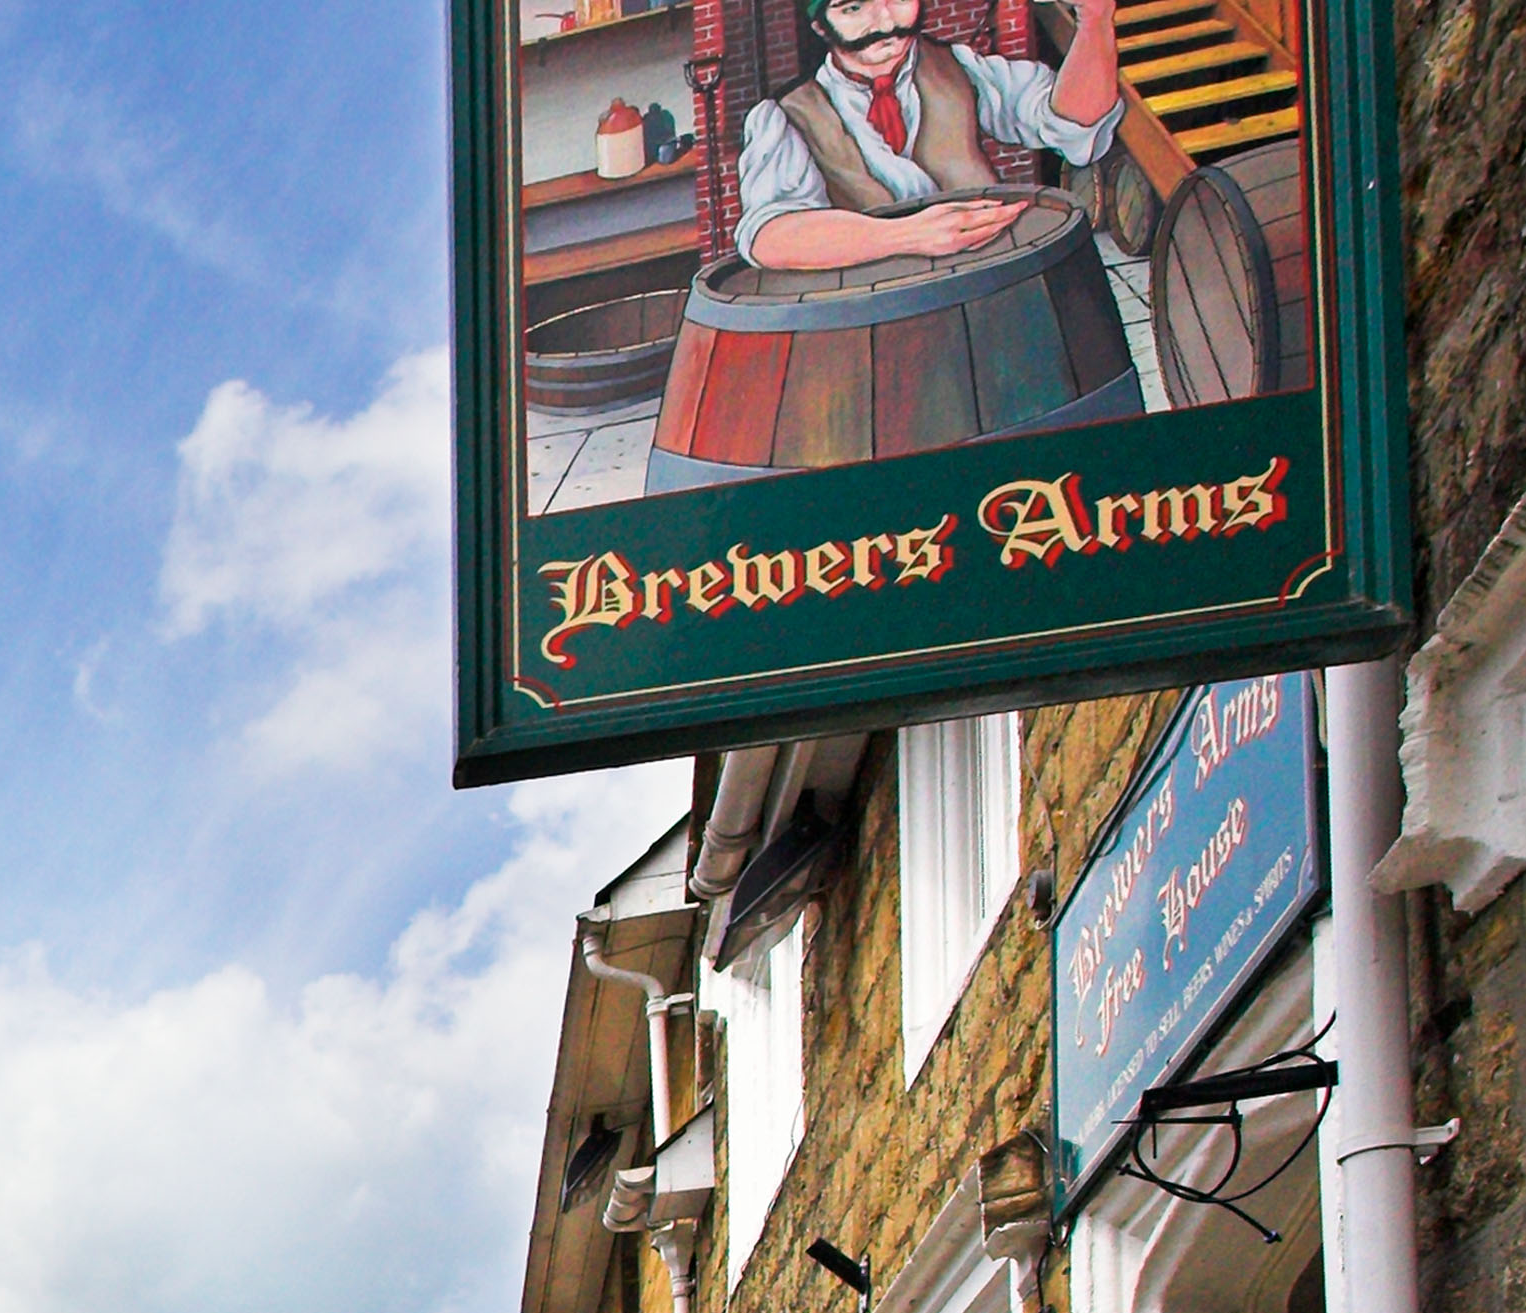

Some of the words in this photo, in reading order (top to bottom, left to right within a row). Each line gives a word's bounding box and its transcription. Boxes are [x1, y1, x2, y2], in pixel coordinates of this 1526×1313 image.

[537, 515, 958, 668] Brewers
[976, 456, 1291, 571] Arms
[1191, 674, 1282, 791] Arms
[1156, 796, 1246, 972] House
